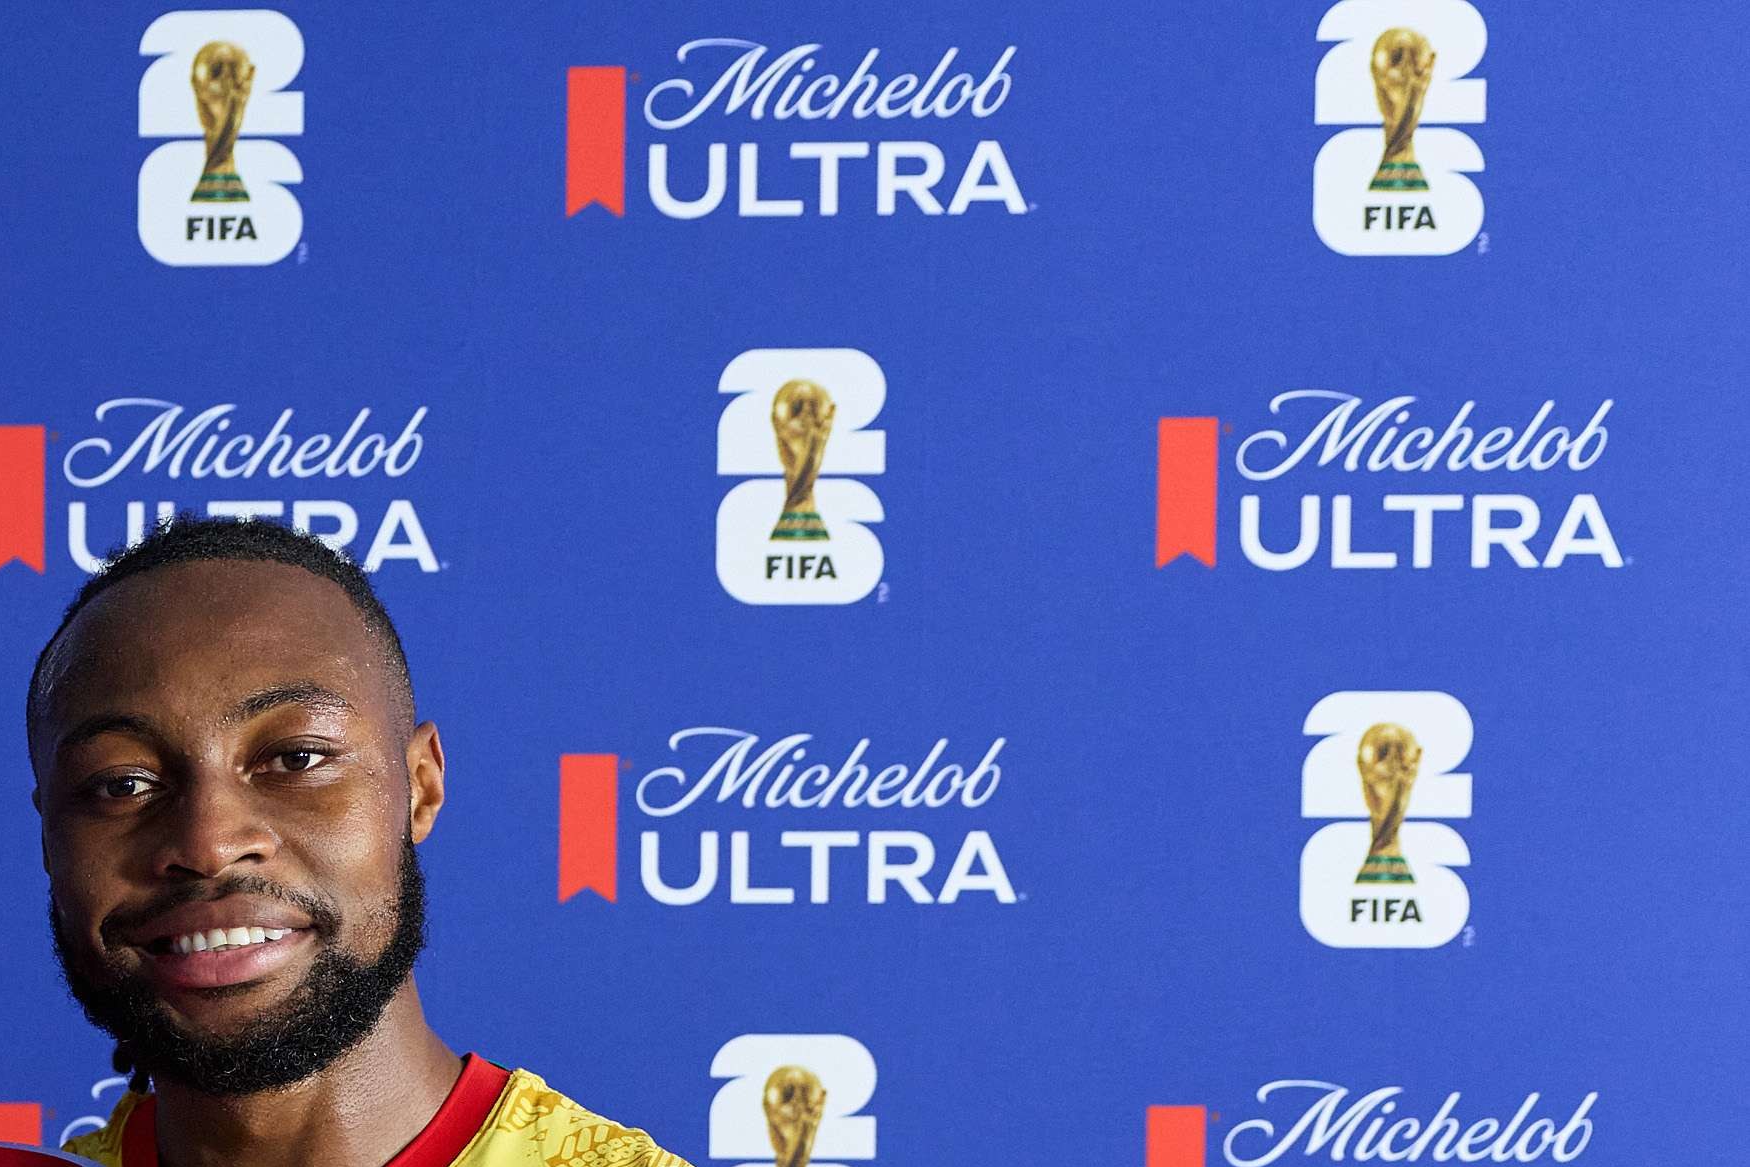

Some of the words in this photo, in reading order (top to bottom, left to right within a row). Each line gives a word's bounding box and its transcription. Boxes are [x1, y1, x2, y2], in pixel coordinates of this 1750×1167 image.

[644, 38, 1017, 129] Michelob
[649, 140, 1028, 219] ULTRA
[1365, 206, 1435, 230] FIFA
[187, 217, 257, 240] FIFA
[64, 398, 427, 487] Michelob
[1236, 390, 1613, 481] Michelob
[766, 556, 836, 579] FIFA
[1240, 494, 1624, 571] ULTRA
[636, 727, 1006, 817] Michelob
[641, 831, 1017, 905] ULTRA
[1351, 899, 1422, 922] FIFA
